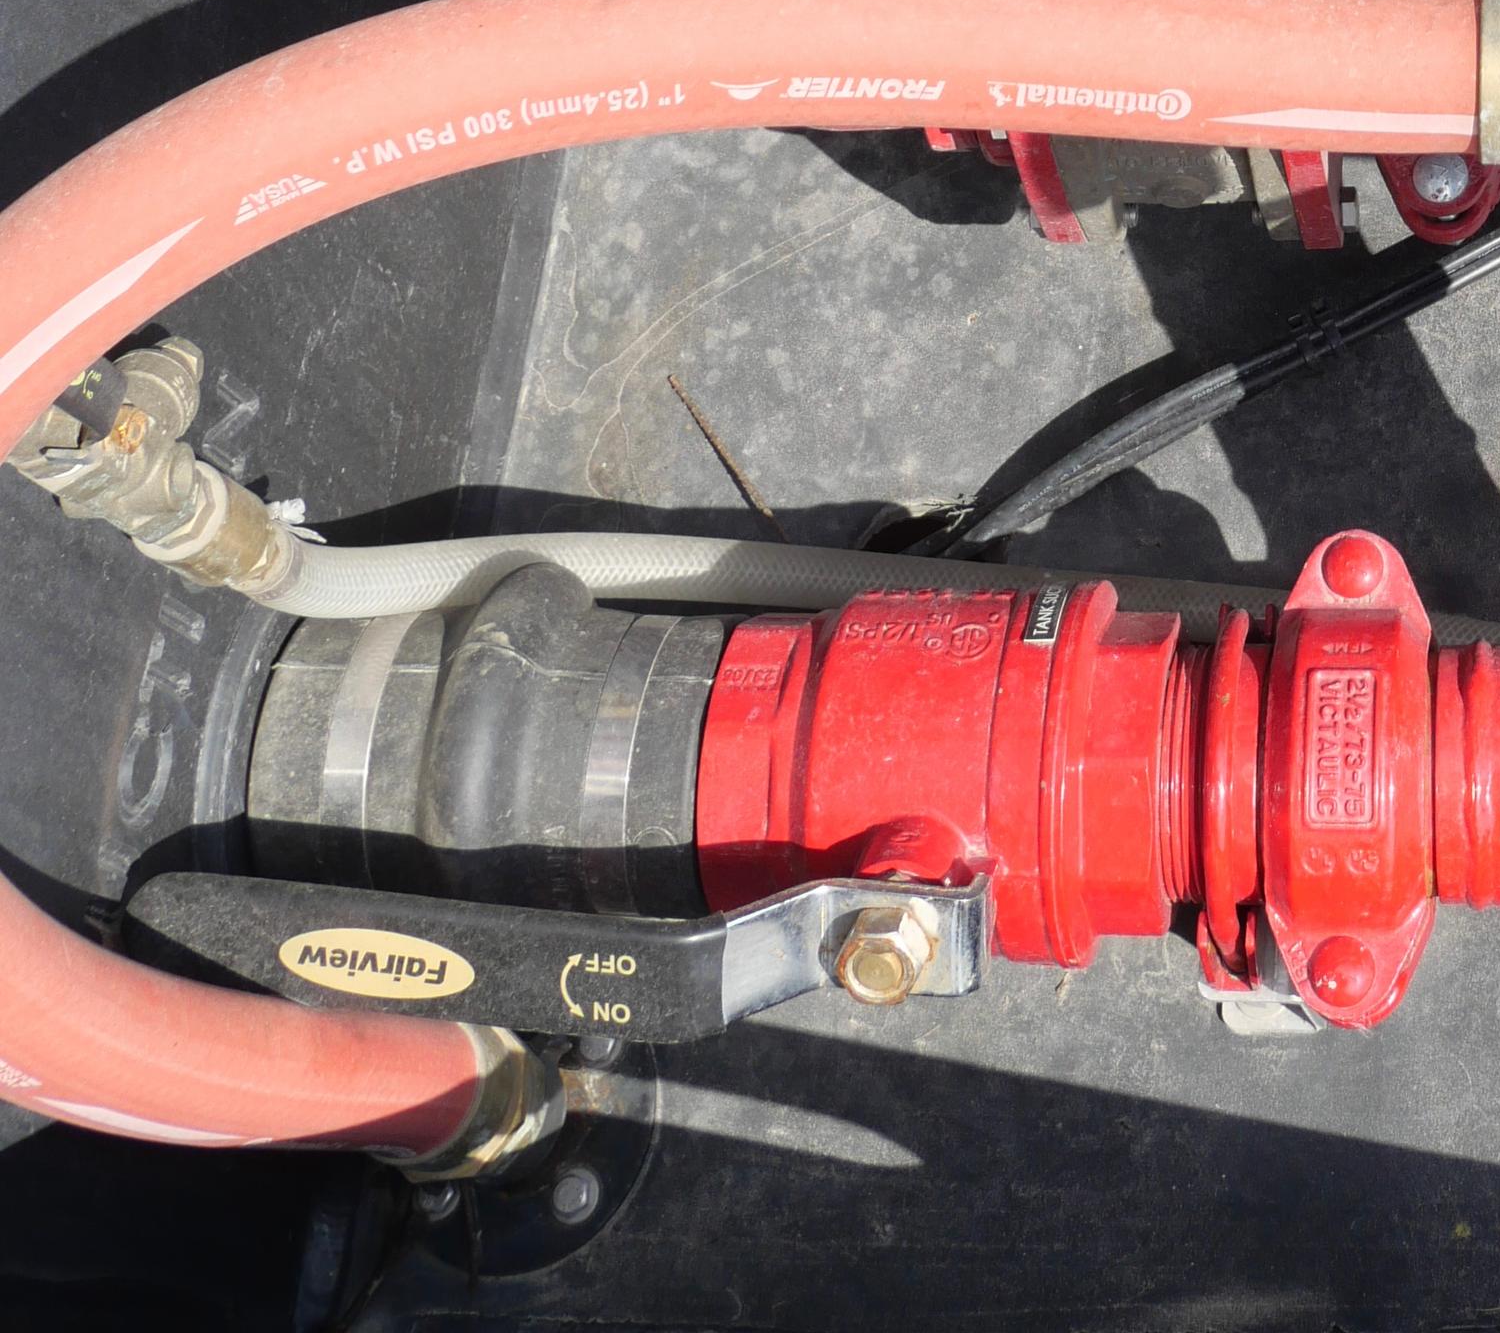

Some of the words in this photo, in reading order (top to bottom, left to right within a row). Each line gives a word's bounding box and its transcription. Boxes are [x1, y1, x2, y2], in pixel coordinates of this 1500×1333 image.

[521, 81, 648, 125] (25.4mm)
[659, 84, 685, 105] 1"
[787, 77, 945, 100] FRONTIER
[1016, 83, 1191, 120] Continental
[407, 123, 456, 153] PSI
[464, 109, 512, 138] 300
[334, 140, 402, 174] W.P.
[246, 175, 297, 208] USA
[1032, 602, 1055, 637] TANK
[1316, 679, 1340, 815] VICTAULIC
[295, 943, 448, 985] Fairview
[584, 951, 637, 975] OFF
[592, 1000, 631, 1023] ON
